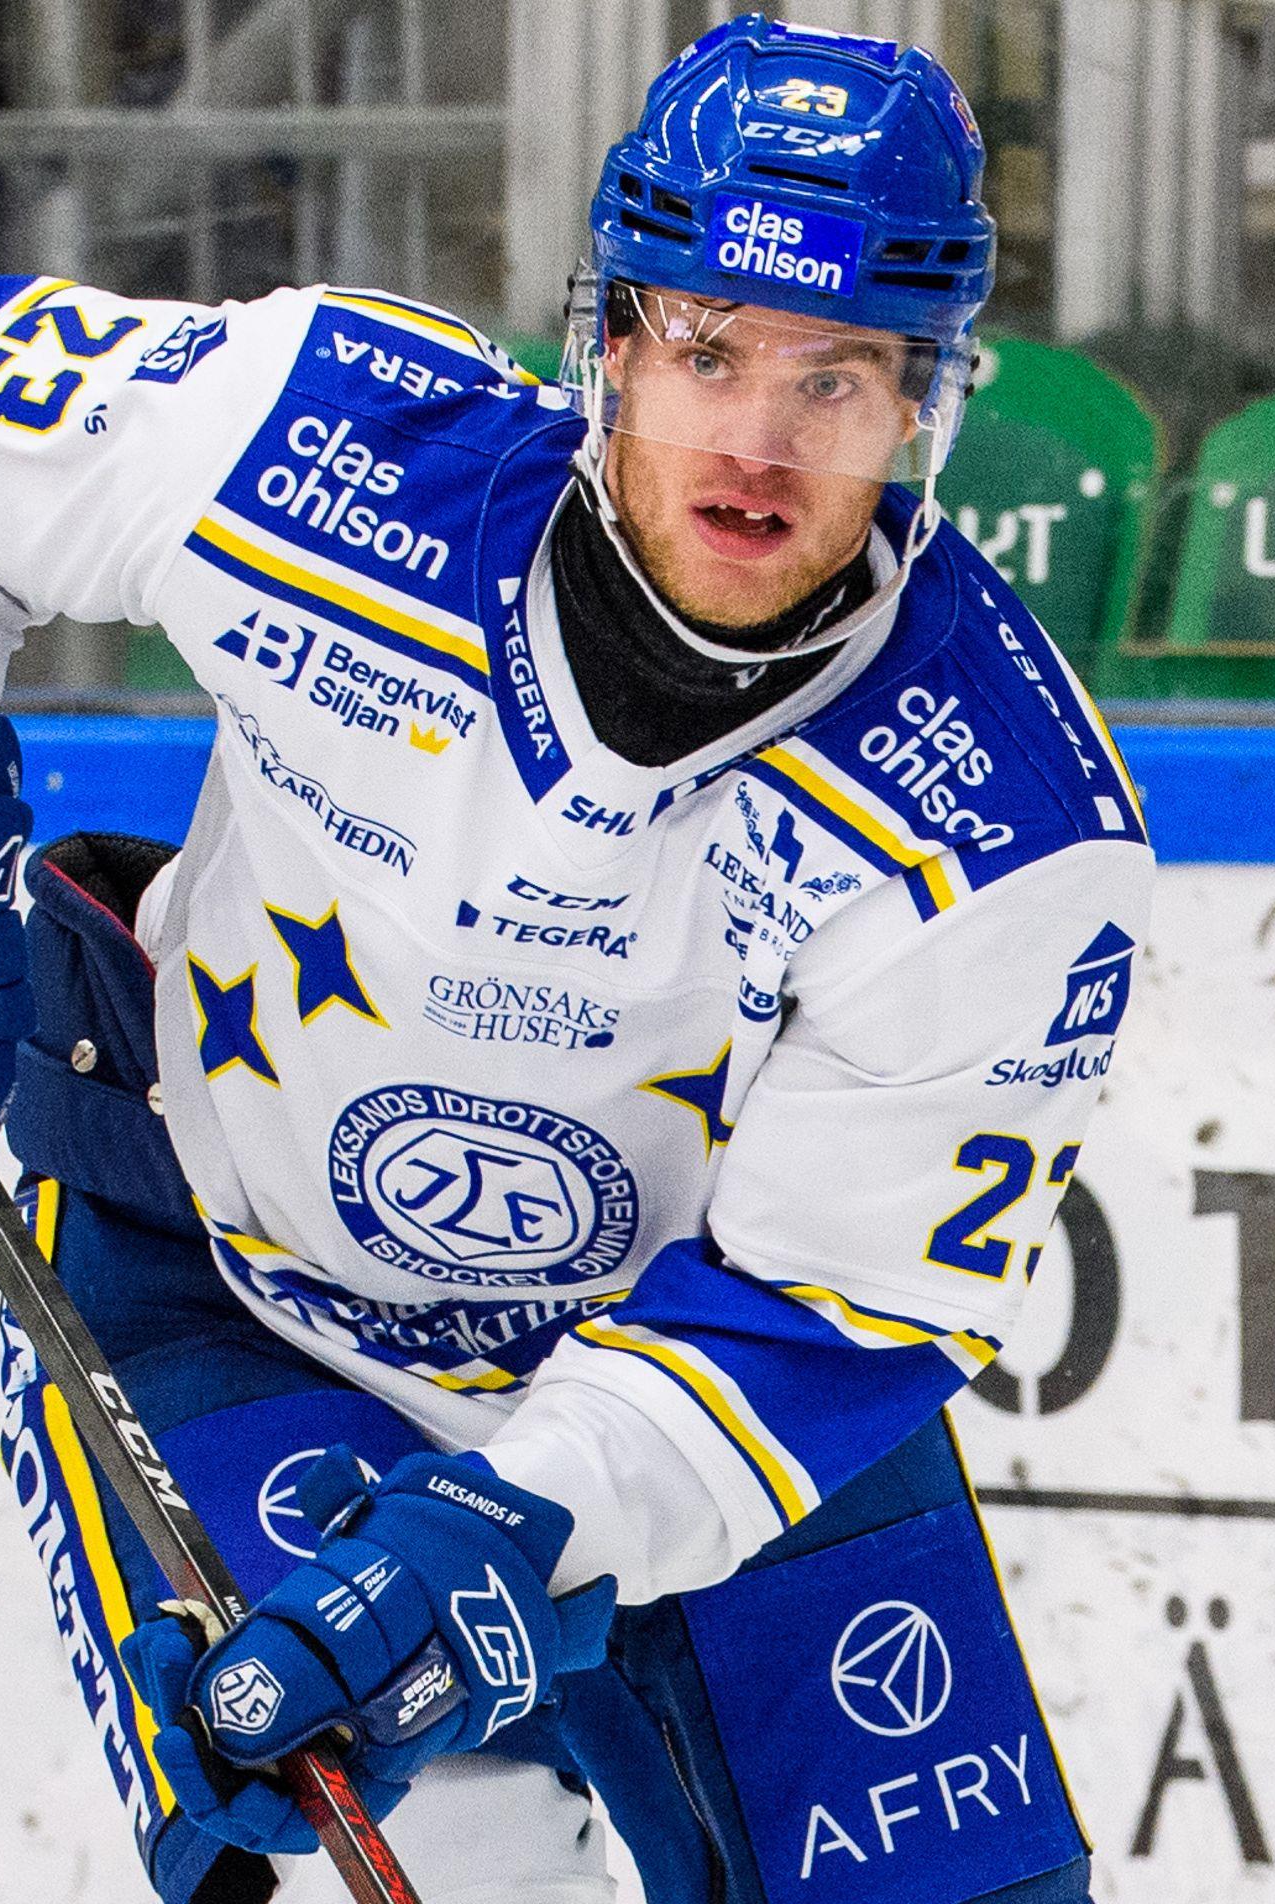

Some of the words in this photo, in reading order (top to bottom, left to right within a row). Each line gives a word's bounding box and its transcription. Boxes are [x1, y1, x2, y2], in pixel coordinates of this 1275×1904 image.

[781, 78, 848, 118] 23
[742, 121, 867, 156] CCM
[725, 202, 804, 245] clas
[717, 236, 843, 291] ohlson
[287, 415, 405, 497] clas
[256, 465, 450, 580] ohlson
[308, 674, 401, 738] Siljan
[323, 640, 478, 739] Bergkvist
[502, 607, 554, 761] TEGERA
[896, 686, 994, 787] clas
[259, 756, 327, 820] KARL
[858, 725, 1015, 852] ohlson
[324, 807, 416, 878] HEDIN
[492, 914, 630, 960] TEGERA
[428, 974, 621, 1030] GRÖNSAKS
[471, 1012, 590, 1051] HUSET
[1064, 971, 1120, 1031] NS
[335, 1088, 429, 1206] LEKSANDS
[362, 1233, 552, 1288] ISHOCKEY
[89, 1370, 191, 1511] CCM
[427, 1475, 508, 1522] LEKSANDS
[504, 1512, 526, 1529] IF
[799, 1733, 1033, 1880] AFRY
